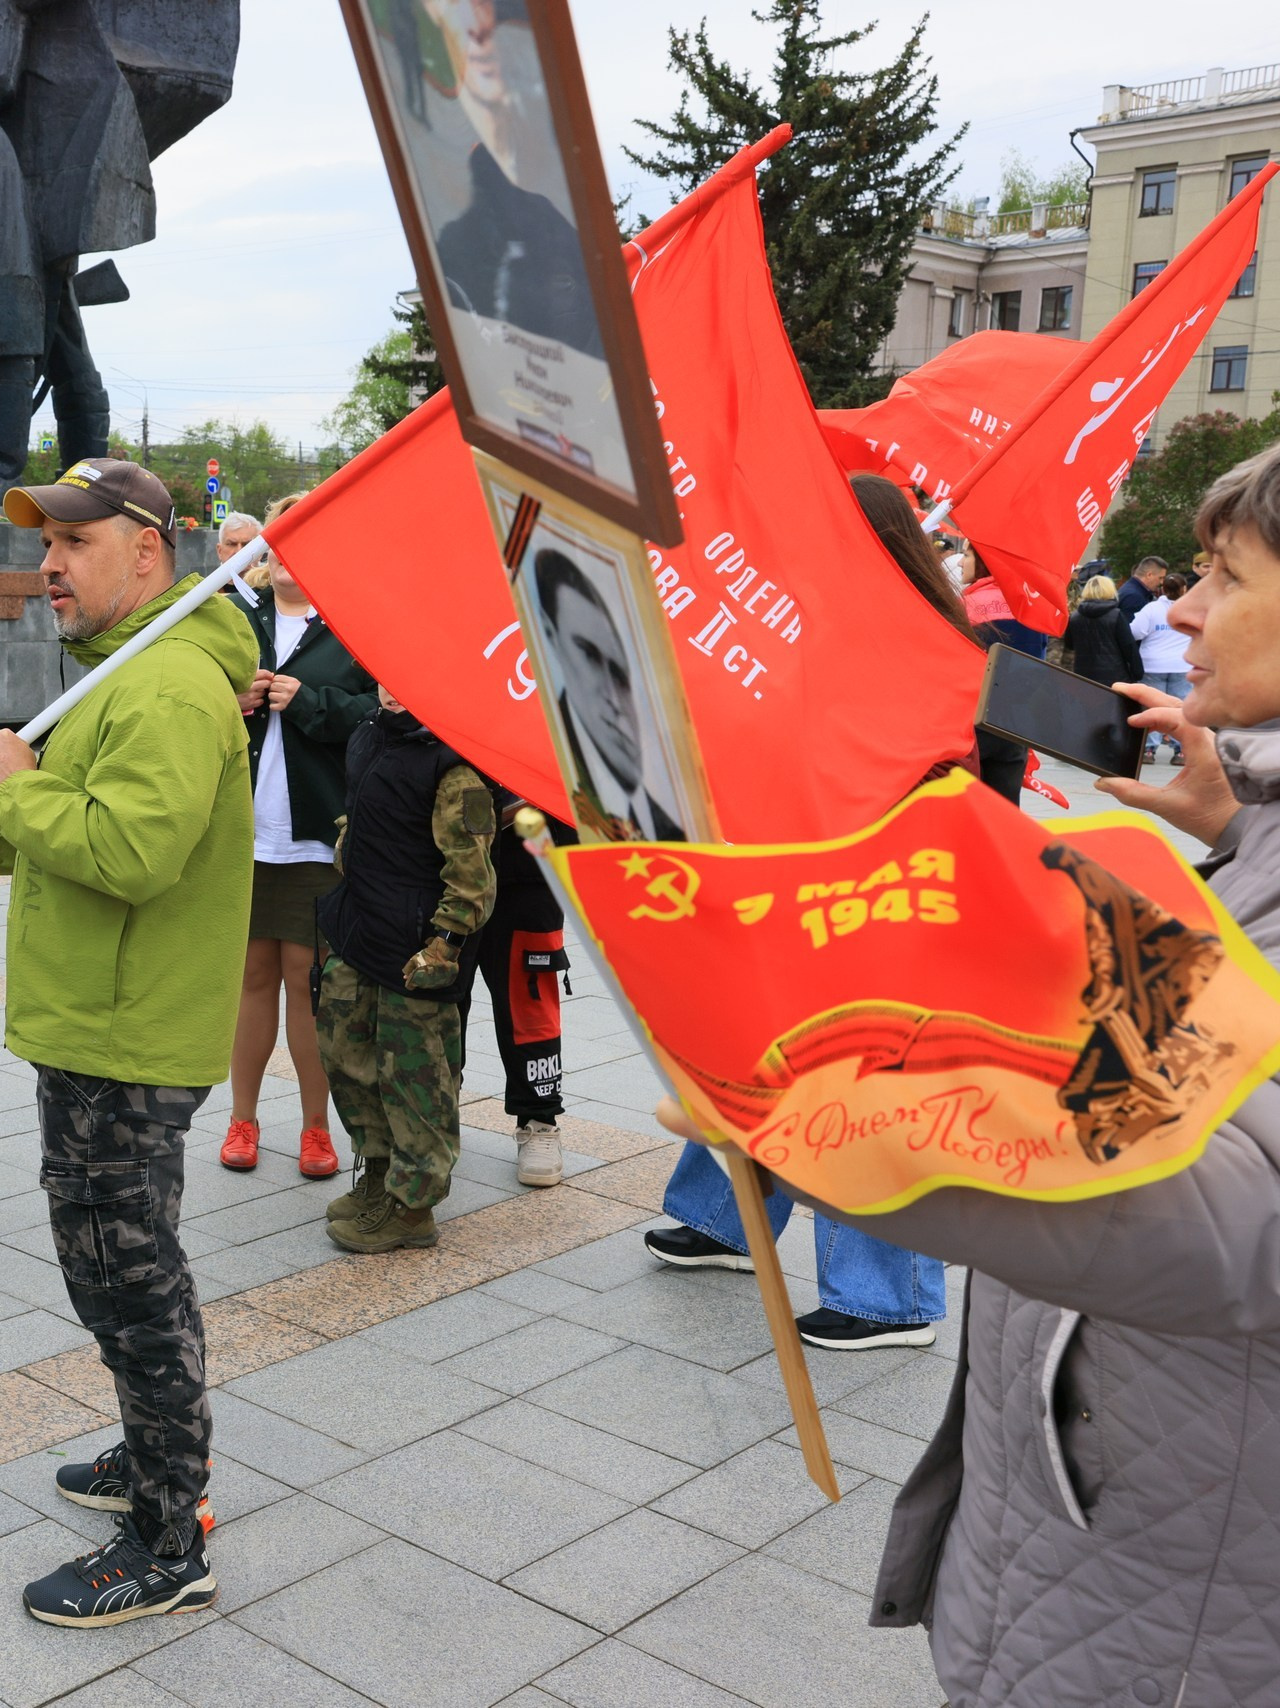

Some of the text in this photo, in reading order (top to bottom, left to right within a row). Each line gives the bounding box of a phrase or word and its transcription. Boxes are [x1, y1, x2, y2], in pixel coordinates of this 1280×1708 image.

[704, 531, 803, 644] ОРДЕНА
[796, 848, 956, 903] МАЯ
[800, 888, 961, 950] 1945
[747, 1085, 1068, 1187] С Днем Победы!
